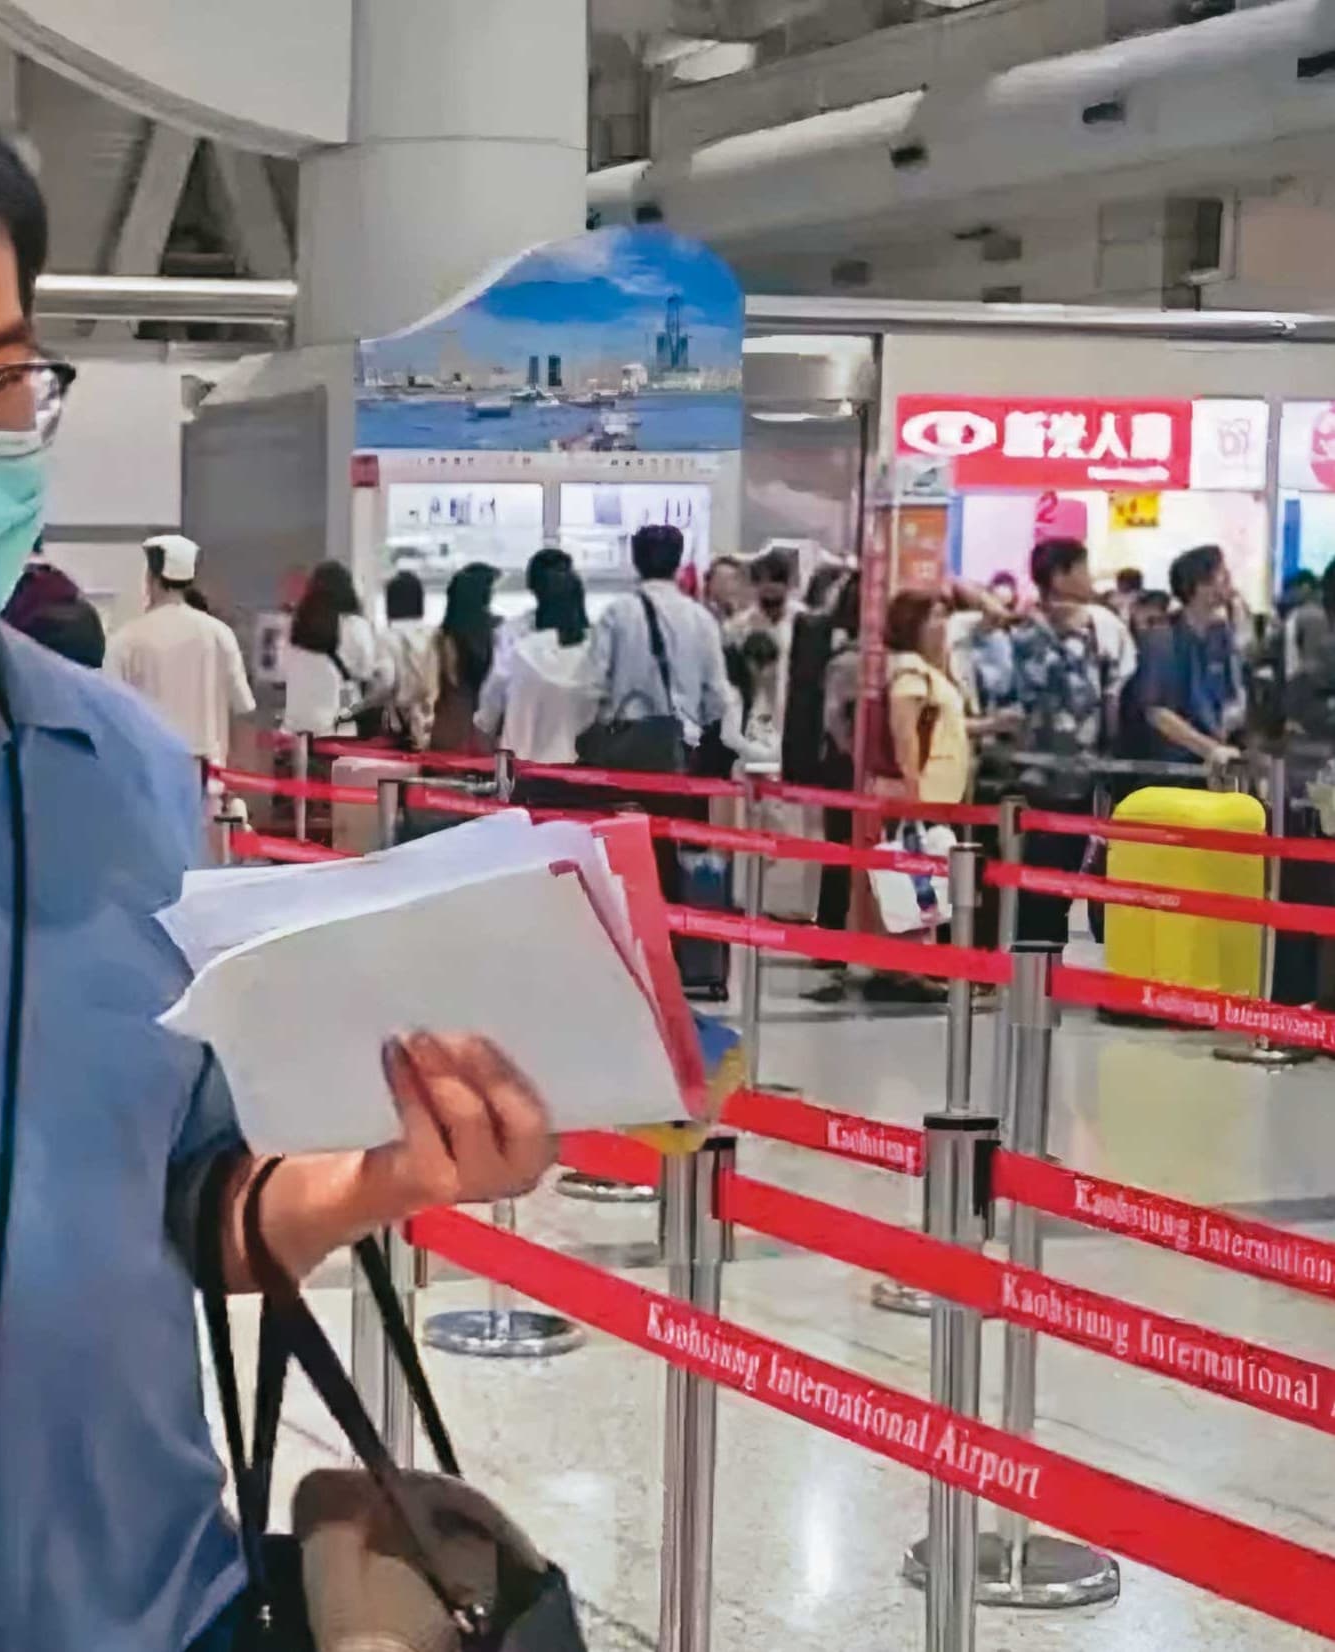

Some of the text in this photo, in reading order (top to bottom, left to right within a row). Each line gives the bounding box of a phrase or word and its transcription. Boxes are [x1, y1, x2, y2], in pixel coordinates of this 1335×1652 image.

[1074, 1178, 1335, 1286] Kaohsiung Internation
[646, 1301, 1042, 1500] Kaohsiung International Airport
[1001, 1272, 1318, 1411] Kaohsiung International
